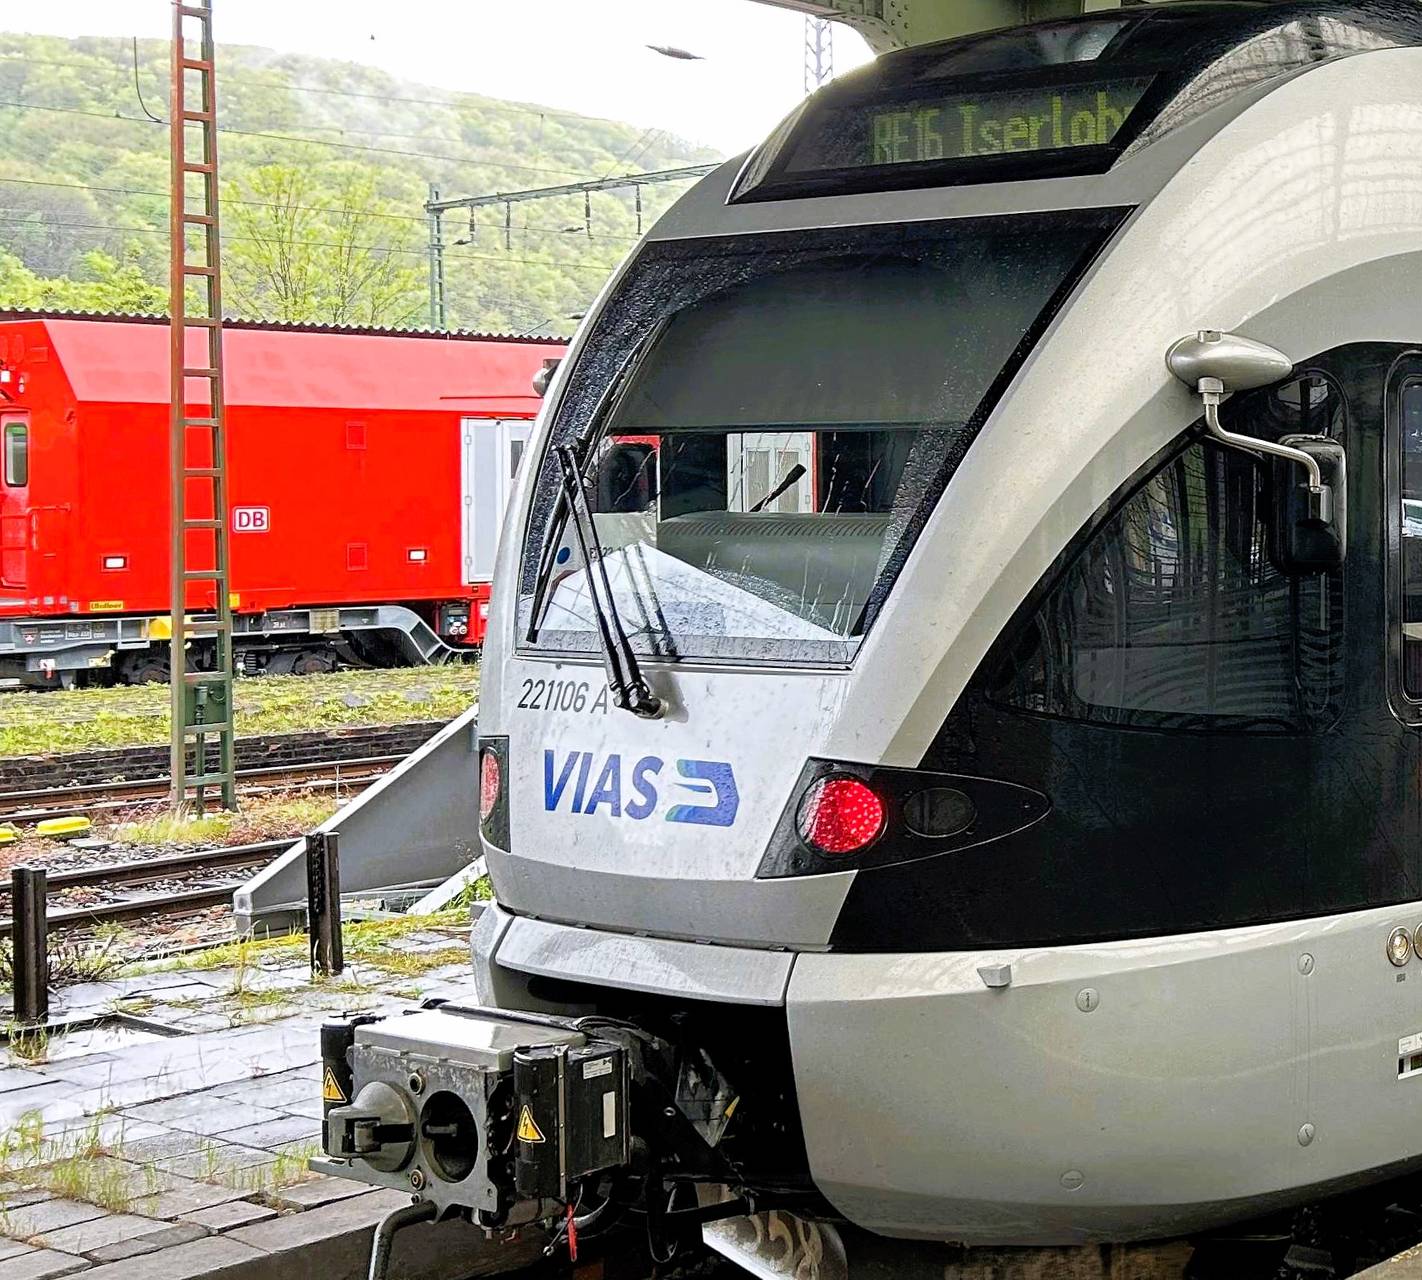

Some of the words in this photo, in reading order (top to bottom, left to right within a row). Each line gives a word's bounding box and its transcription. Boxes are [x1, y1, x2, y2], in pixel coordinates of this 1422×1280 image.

[872, 109, 943, 165] RE16
[959, 90, 1134, 157] Iserloh
[238, 511, 265, 528] DB
[516, 678, 590, 712] 221106
[590, 683, 608, 714] A
[544, 749, 664, 820] VIAS
